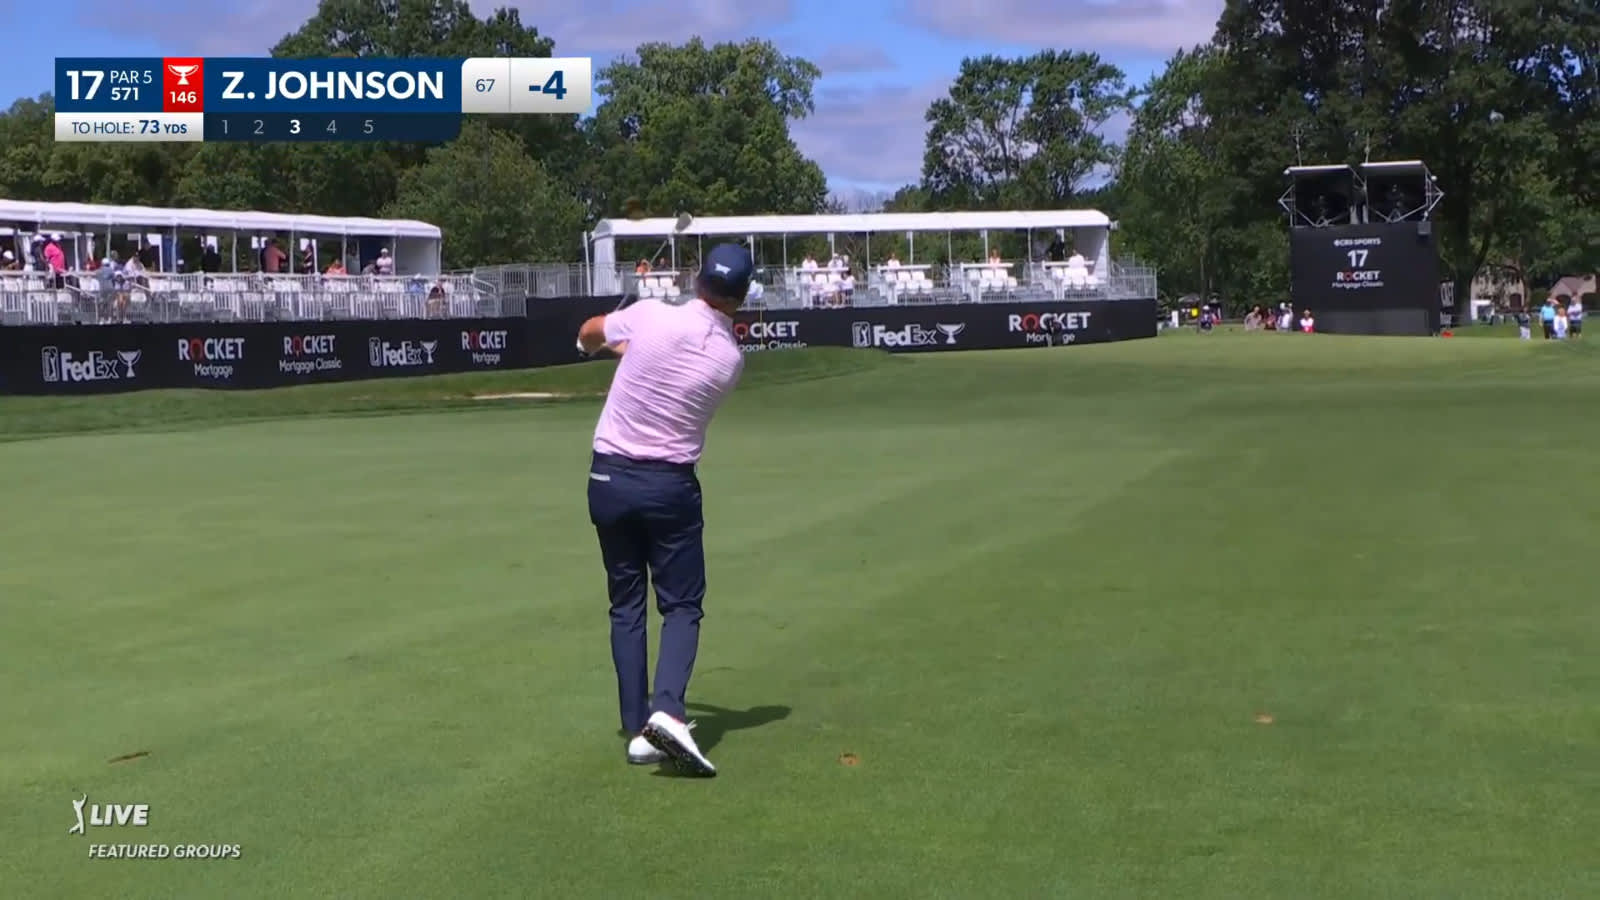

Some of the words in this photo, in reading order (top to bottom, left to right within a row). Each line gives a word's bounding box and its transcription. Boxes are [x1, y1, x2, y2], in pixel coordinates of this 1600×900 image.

[1354, 238, 1381, 246] SPORTS
[1347, 250, 1368, 267] 17
[1336, 270, 1381, 281] ROCKET
[461, 330, 508, 350] ROCKET
[734, 321, 800, 340] OCKET
[873, 324, 938, 347] FedEx
[178, 337, 245, 361] ROCKET
[283, 335, 336, 356] ROCKET
[383, 341, 423, 366] FedEx
[60, 350, 119, 382] FedEx
[279, 359, 315, 374] Mortgage
[315, 357, 342, 371] Classic
[472, 353, 501, 364] Mortgage
[194, 363, 234, 379] Mortgage
